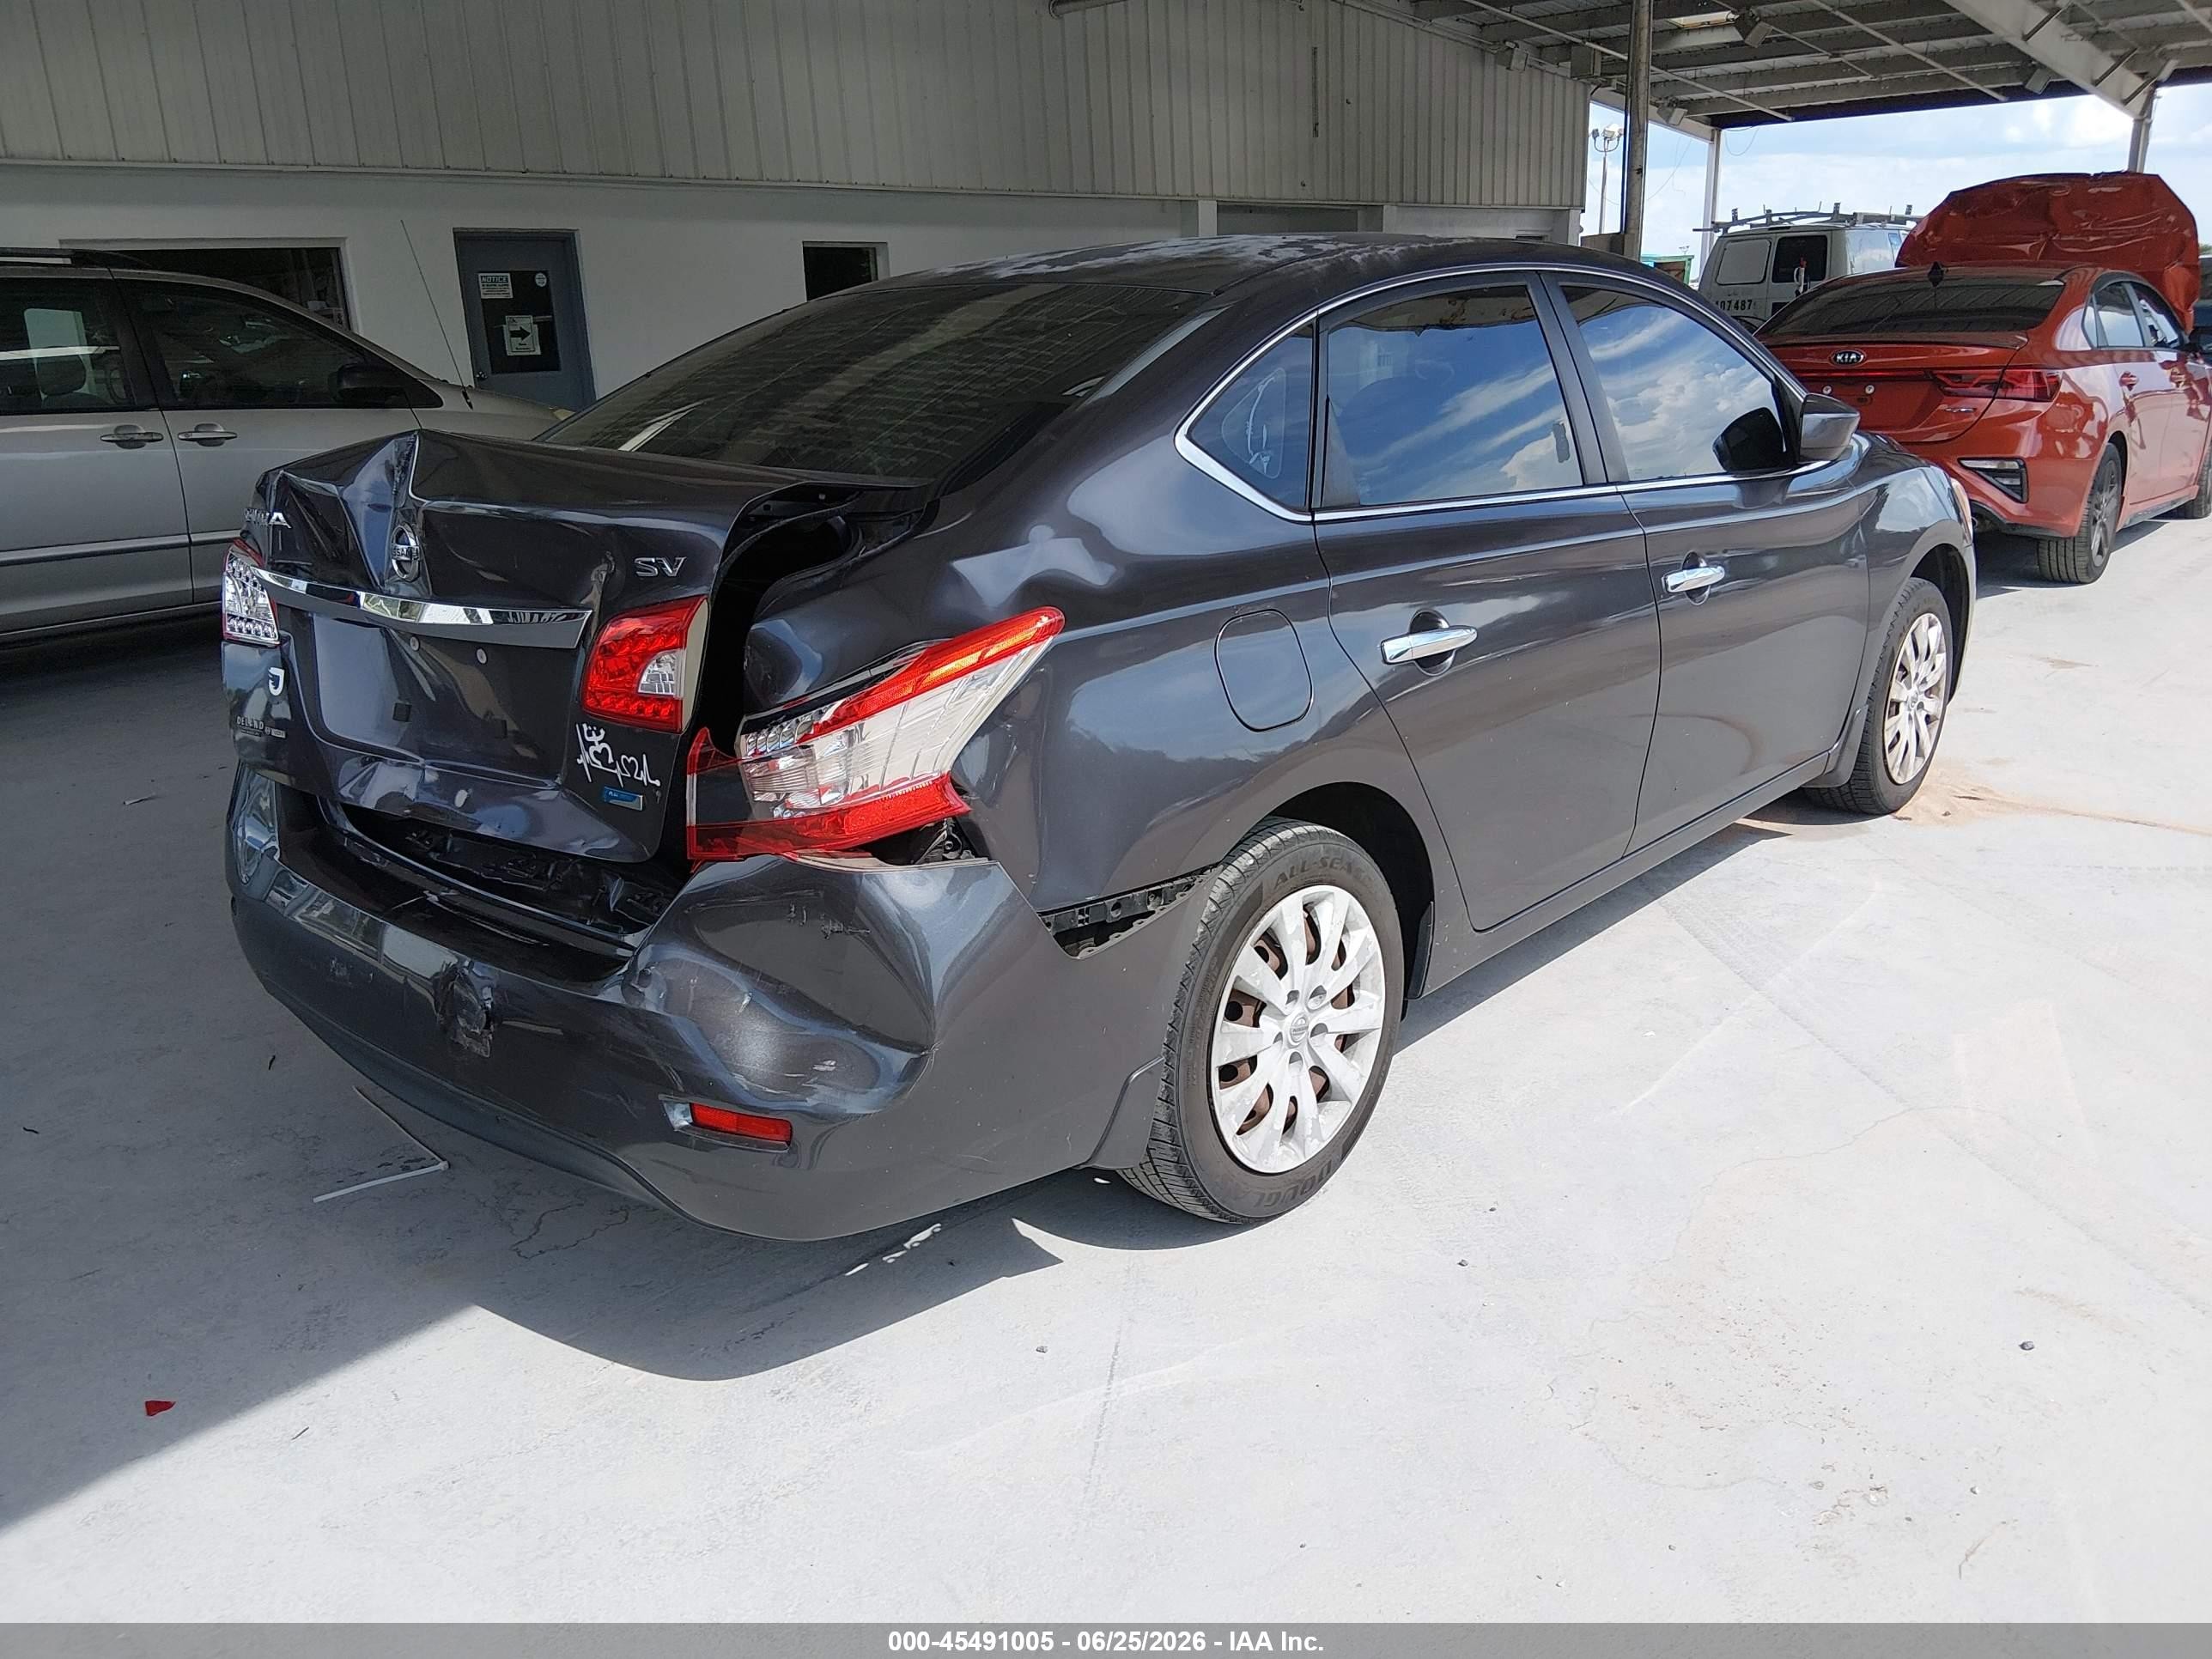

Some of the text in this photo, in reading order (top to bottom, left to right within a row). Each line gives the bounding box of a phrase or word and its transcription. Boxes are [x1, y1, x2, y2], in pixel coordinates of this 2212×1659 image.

[1837, 353, 1857, 362] KIA
[635, 556, 686, 576] SV
[1273, 856, 1377, 890] ALL-SEA
